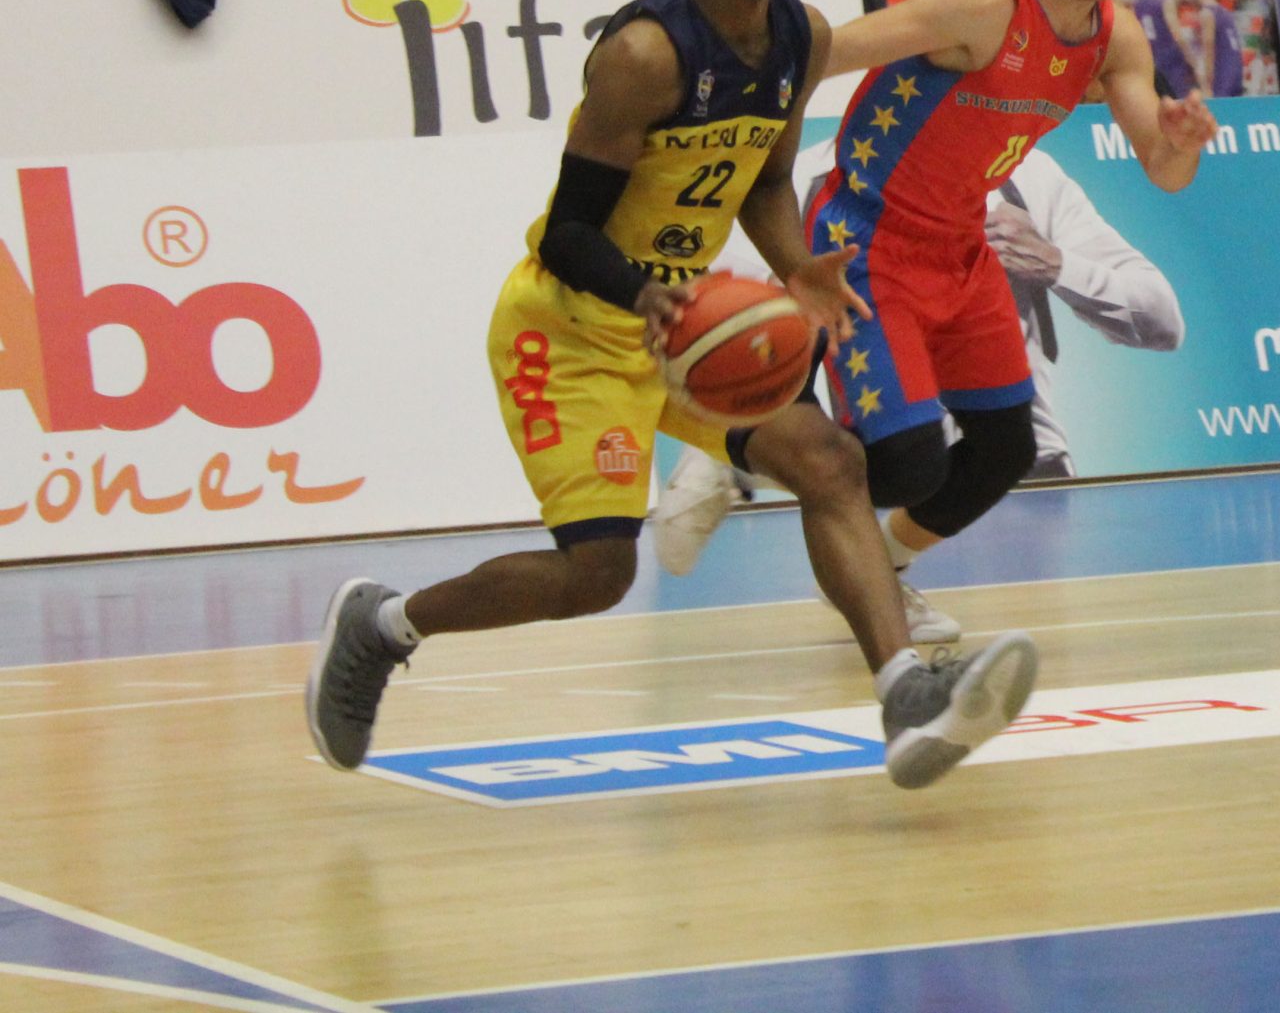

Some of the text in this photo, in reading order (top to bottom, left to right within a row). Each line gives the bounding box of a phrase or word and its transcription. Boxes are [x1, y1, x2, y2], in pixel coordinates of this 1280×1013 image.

[675, 160, 737, 207] 22
[0, 446, 366, 525] öner
[428, 734, 862, 786] BMI
